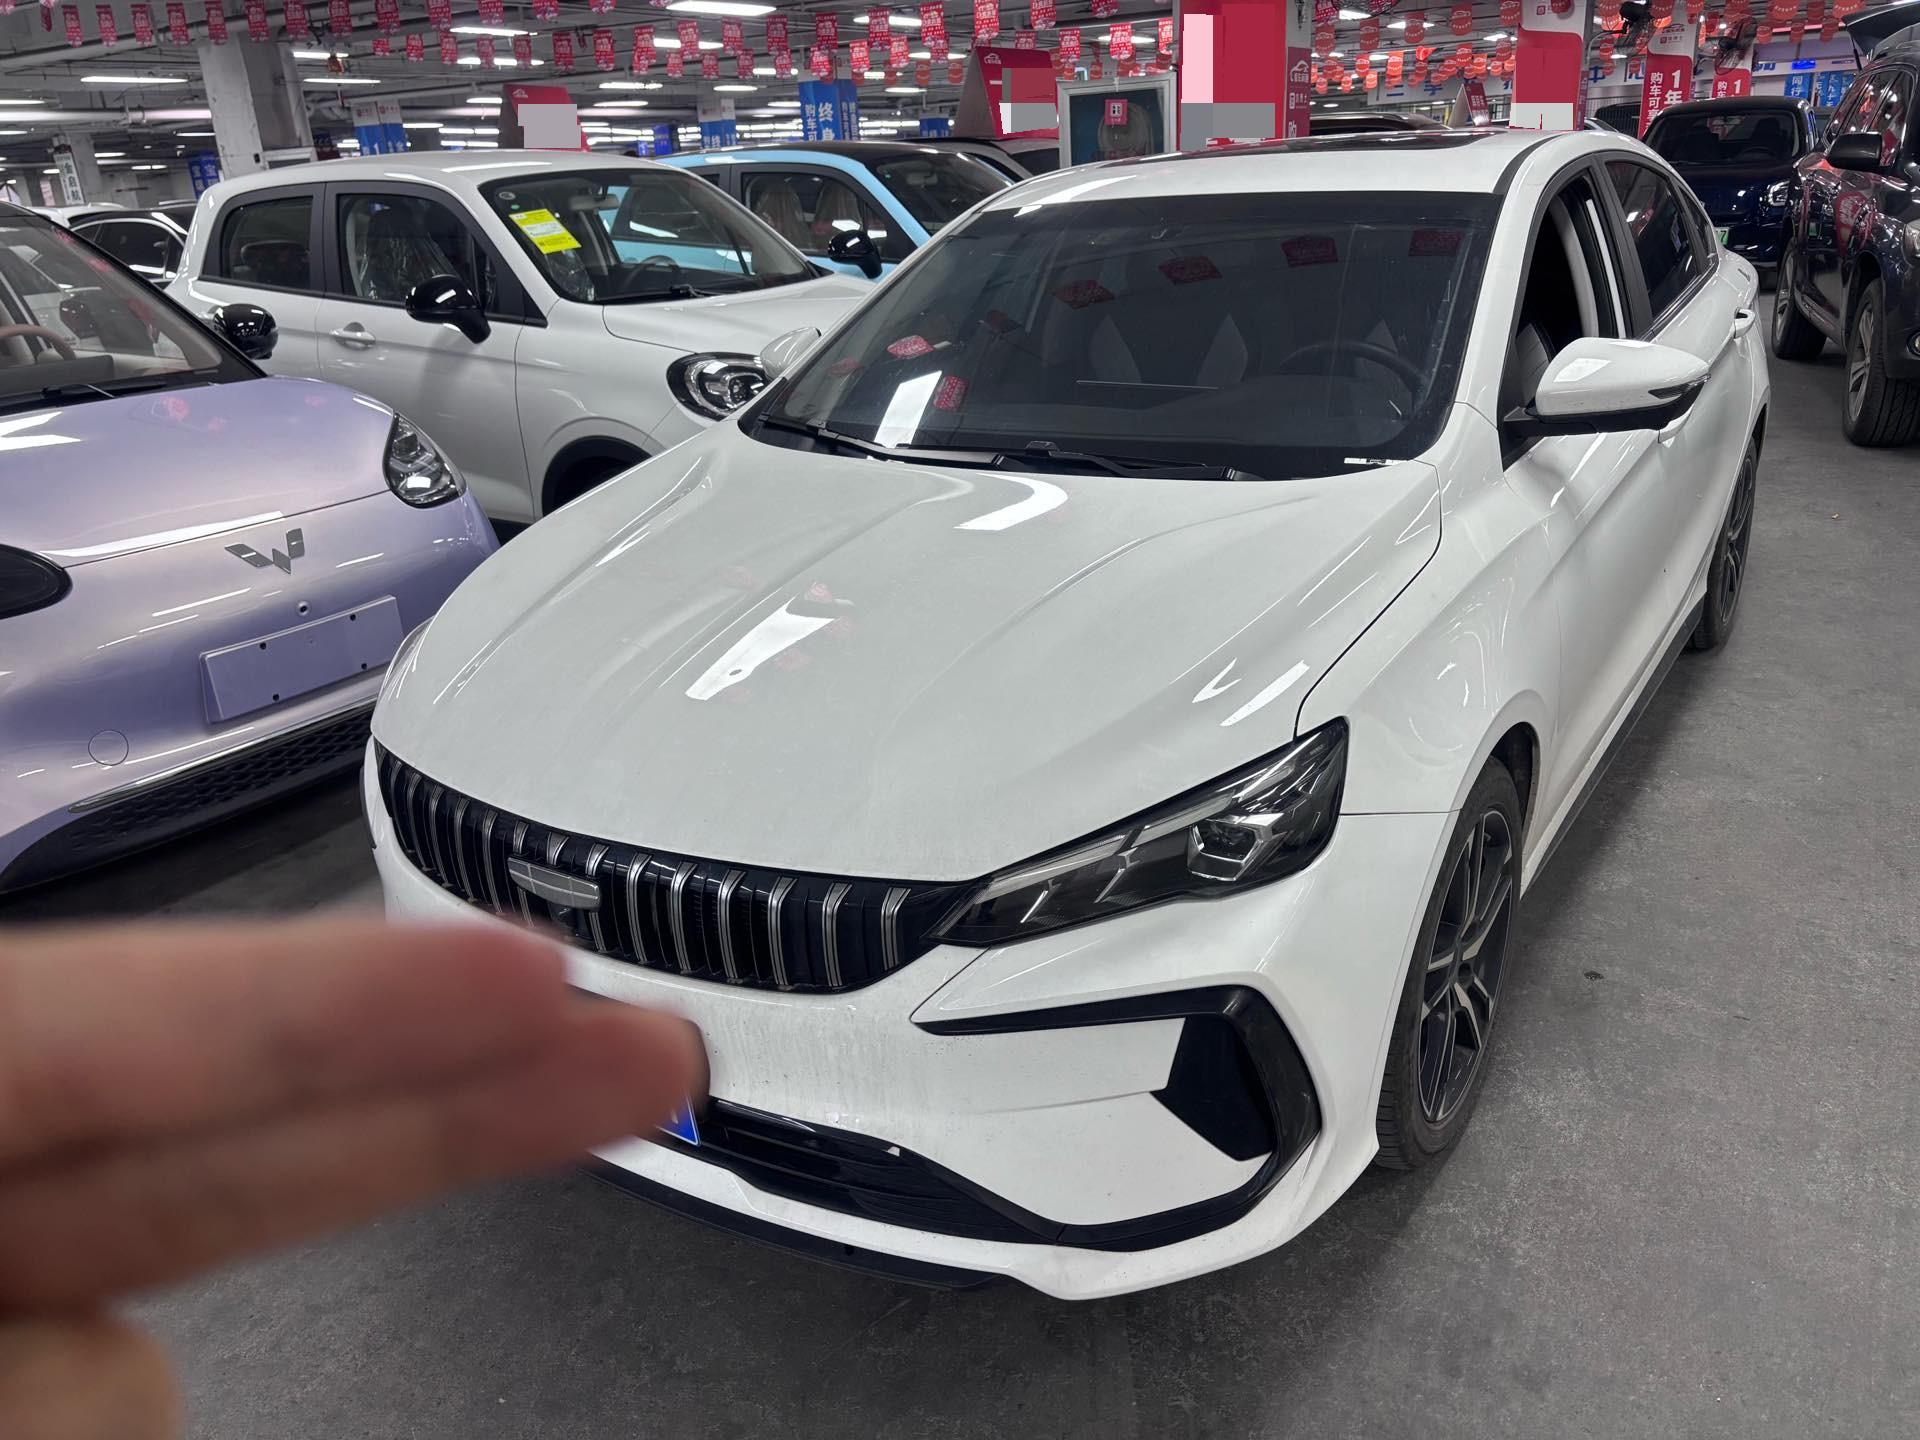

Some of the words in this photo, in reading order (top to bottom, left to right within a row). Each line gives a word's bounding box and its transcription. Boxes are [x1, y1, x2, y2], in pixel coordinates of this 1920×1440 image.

[1645, 72, 1664, 128] 购车可享
[1664, 69, 1683, 105] 1年
